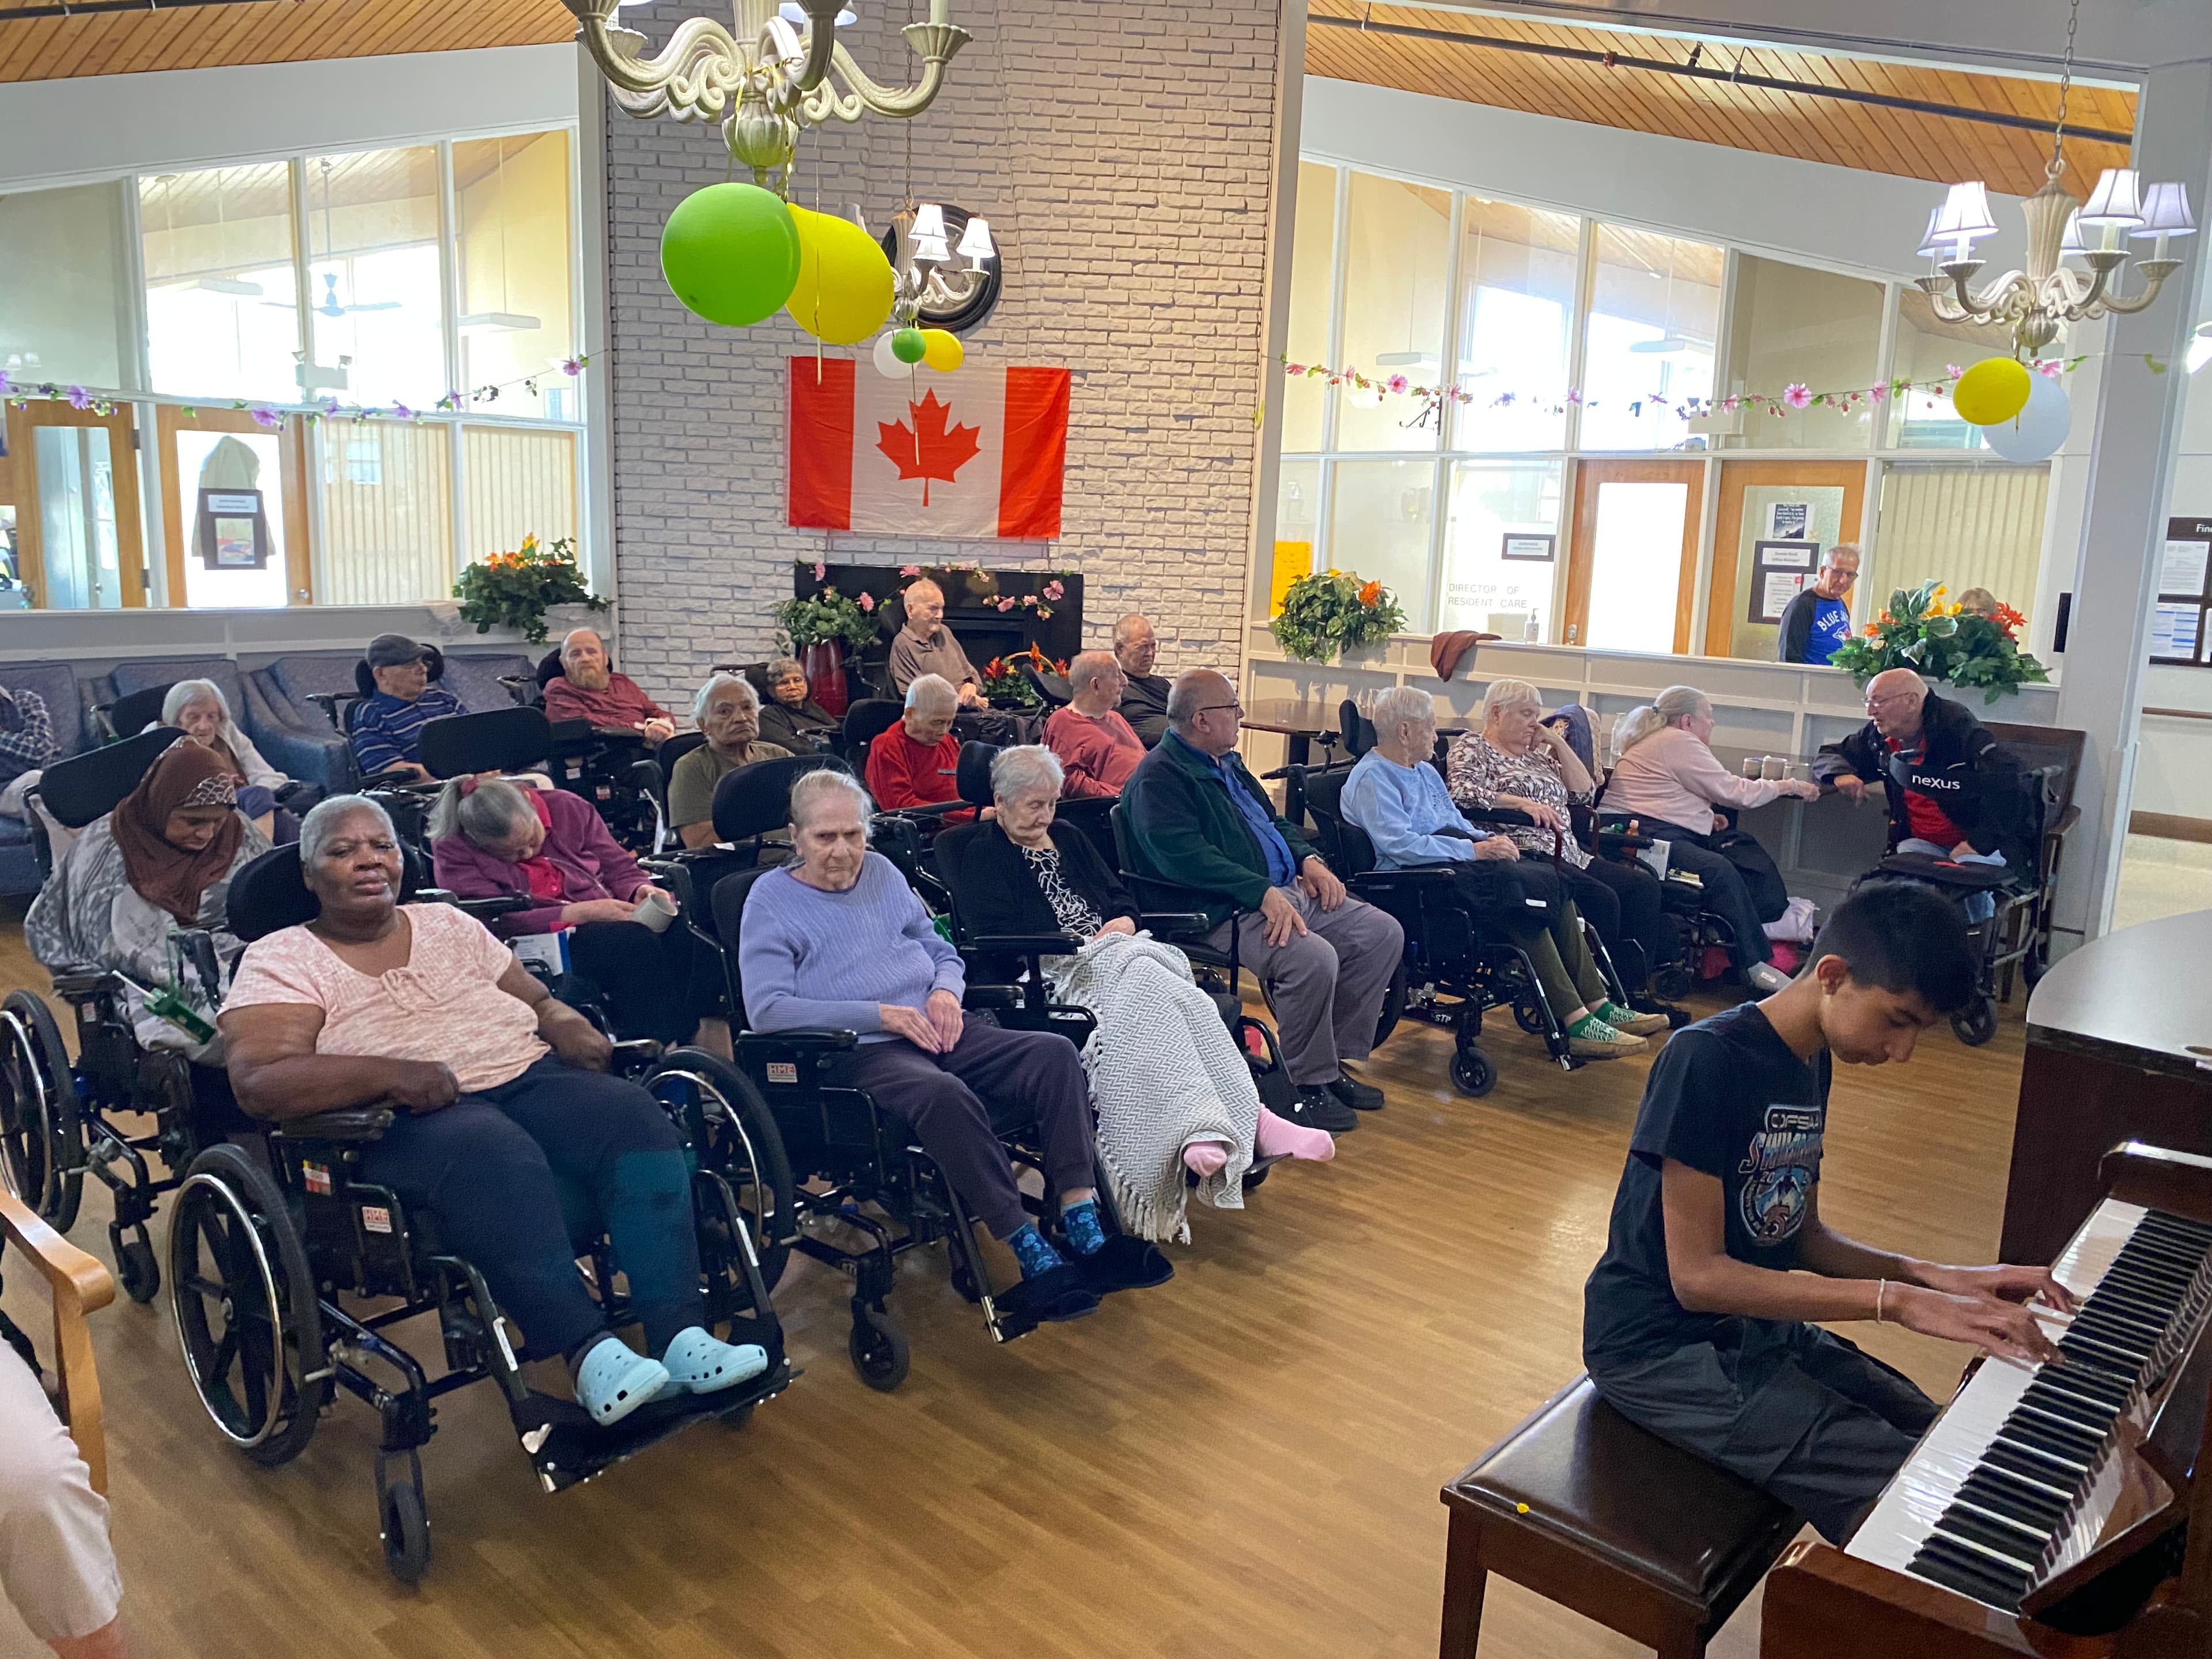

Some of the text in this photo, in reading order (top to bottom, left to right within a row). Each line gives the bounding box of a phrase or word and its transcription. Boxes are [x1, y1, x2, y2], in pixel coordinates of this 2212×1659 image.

[1449, 583, 1520, 594] DIRECTOR OF
[1448, 597, 1527, 608] RESIDENT CARE
[1817, 610, 1840, 631] BLUE
[1434, 1014, 1452, 1024] STP
[768, 1065, 794, 1074] HME
